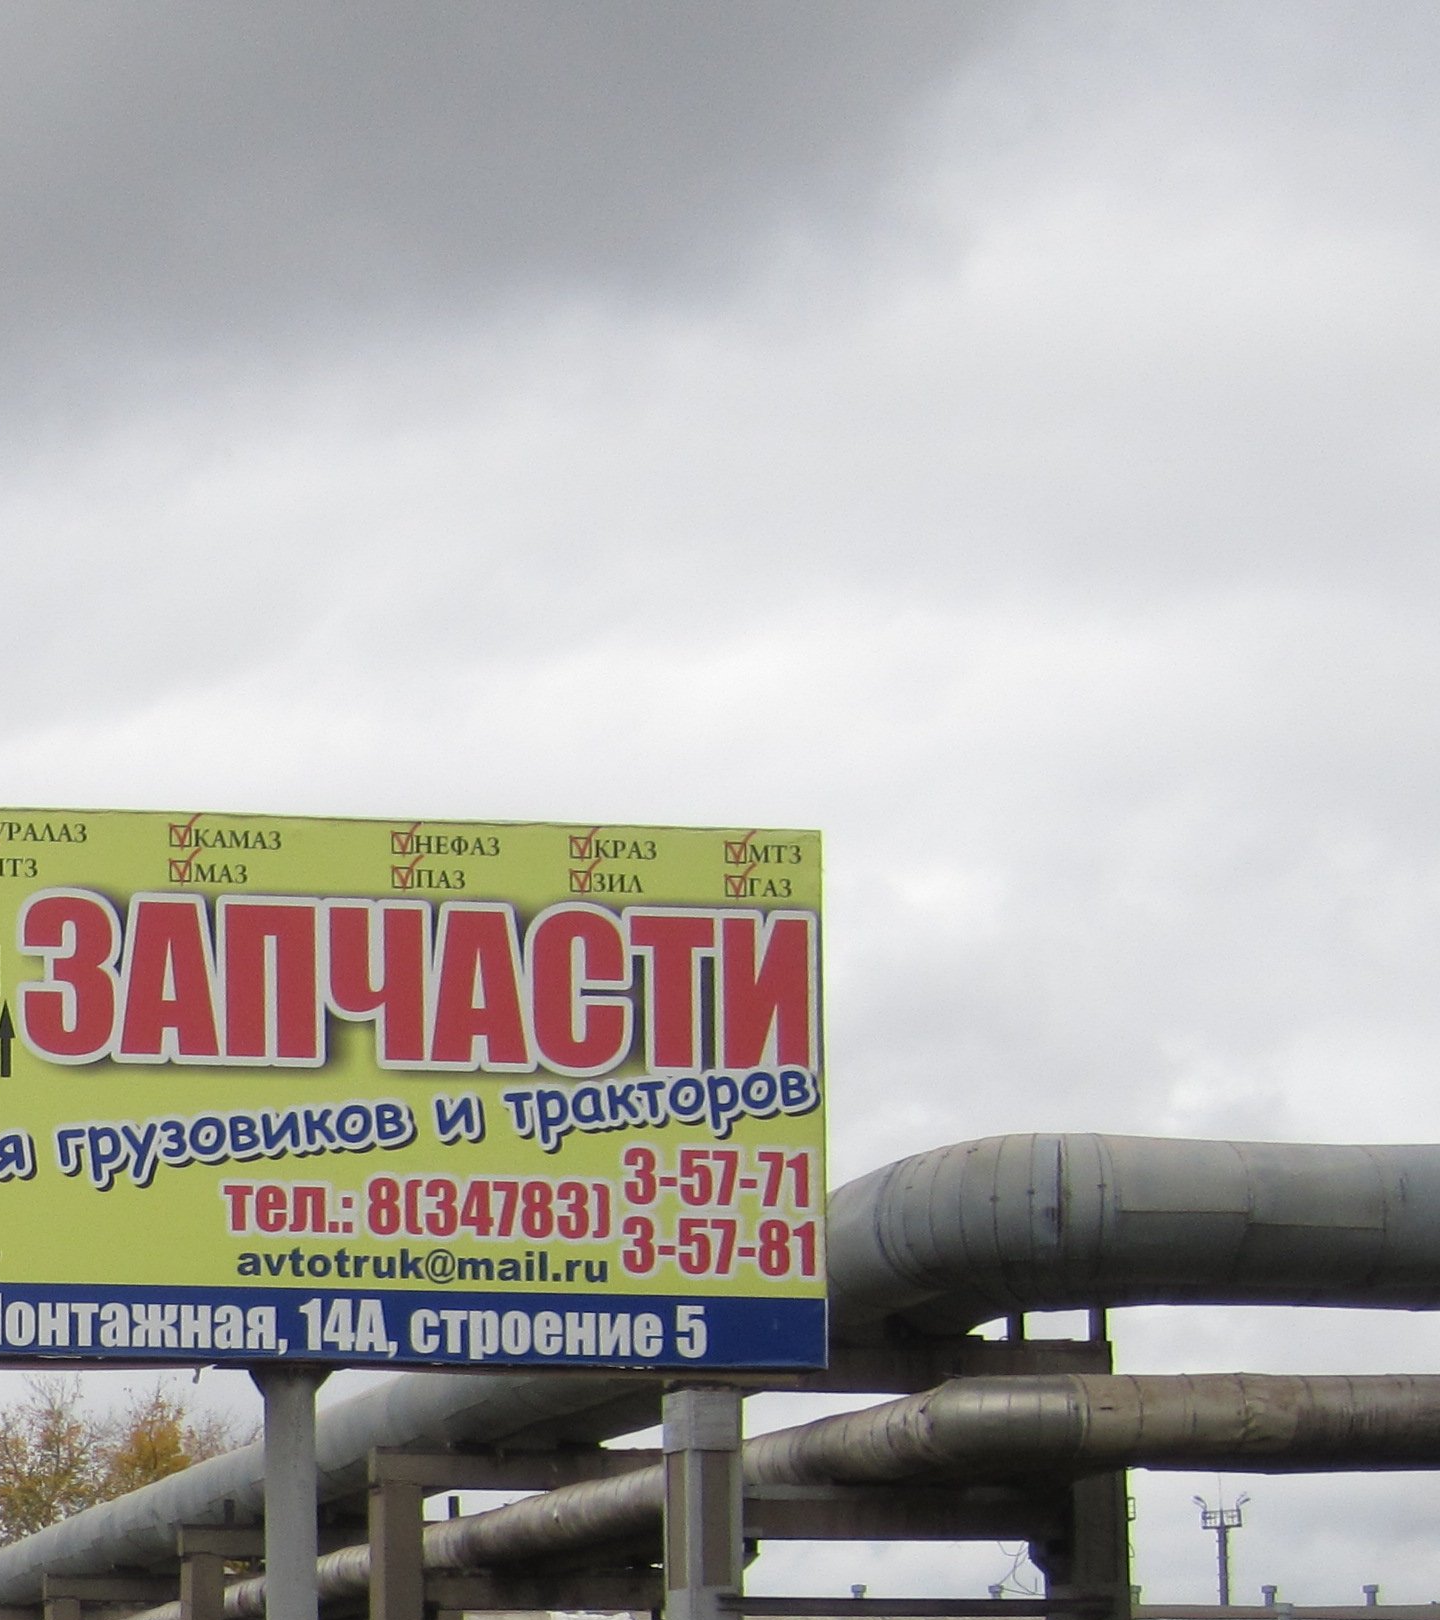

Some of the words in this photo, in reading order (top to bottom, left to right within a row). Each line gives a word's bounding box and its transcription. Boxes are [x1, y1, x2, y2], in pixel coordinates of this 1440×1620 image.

[193, 829, 282, 851] КАМАЗ
[414, 834, 500, 858] НЕФАЗ
[594, 839, 657, 861] КРАЗ
[748, 844, 802, 866] МТЗ
[194, 863, 248, 885] МАЗ
[416, 868, 466, 890] ПАЗ
[593, 873, 644, 895] ЗИЛ
[747, 877, 793, 898] ГАЗ
[21, 893, 812, 1073] ЗАПЧАСТИ
[57, 1101, 411, 1184] грузовиков
[436, 1097, 480, 1137] и
[504, 1069, 812, 1147] тракторов
[624, 1147, 810, 1208] 3-57-71
[223, 1183, 354, 1234] тел.:
[367, 1177, 611, 1240] 8(34783)
[622, 1216, 817, 1277] 3-57-81
[236, 1247, 609, 1285] avtotruk@mail.ru
[298, 1297, 398, 1359] 14А,
[410, 1303, 664, 1360] строение
[675, 1304, 708, 1359] 5
